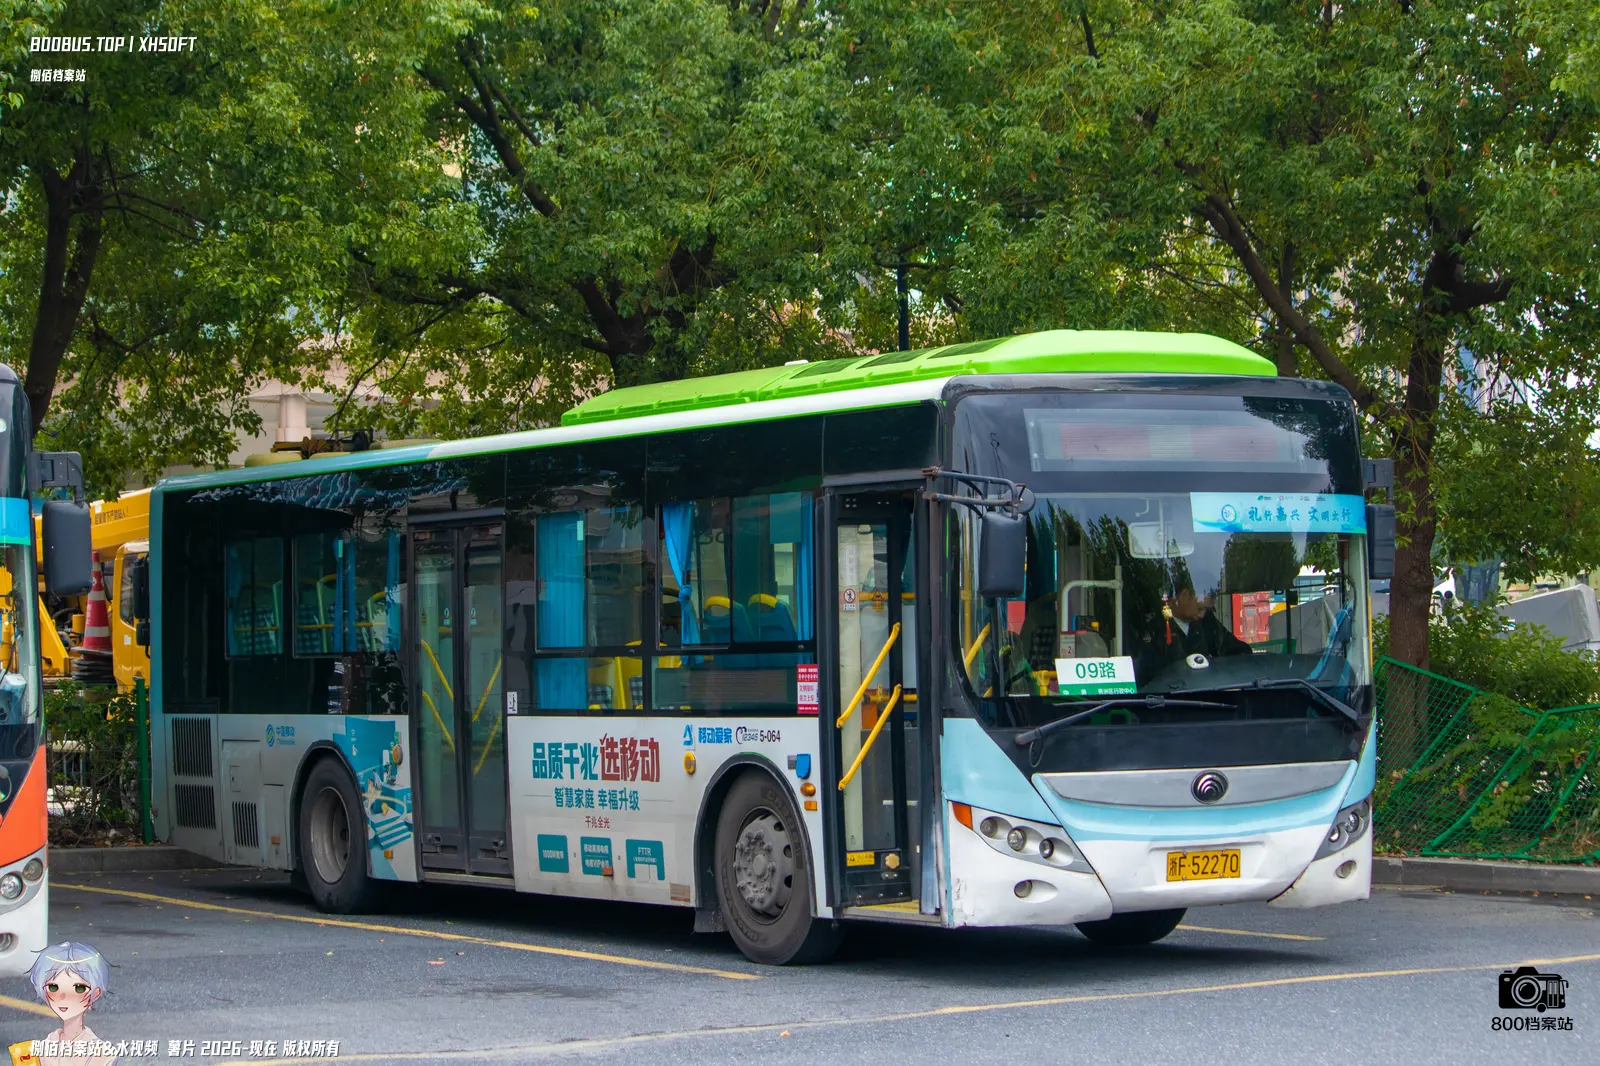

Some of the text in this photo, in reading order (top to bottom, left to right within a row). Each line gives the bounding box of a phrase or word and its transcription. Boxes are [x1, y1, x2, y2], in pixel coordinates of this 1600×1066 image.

[1075, 661, 1116, 679] 09路
[698, 727, 732, 744] 移动爱家
[760, 730, 781, 743] 5-064
[554, 787, 640, 811] 智慧家庭 幸福升级
[585, 816, 611, 829] 千兆全光
